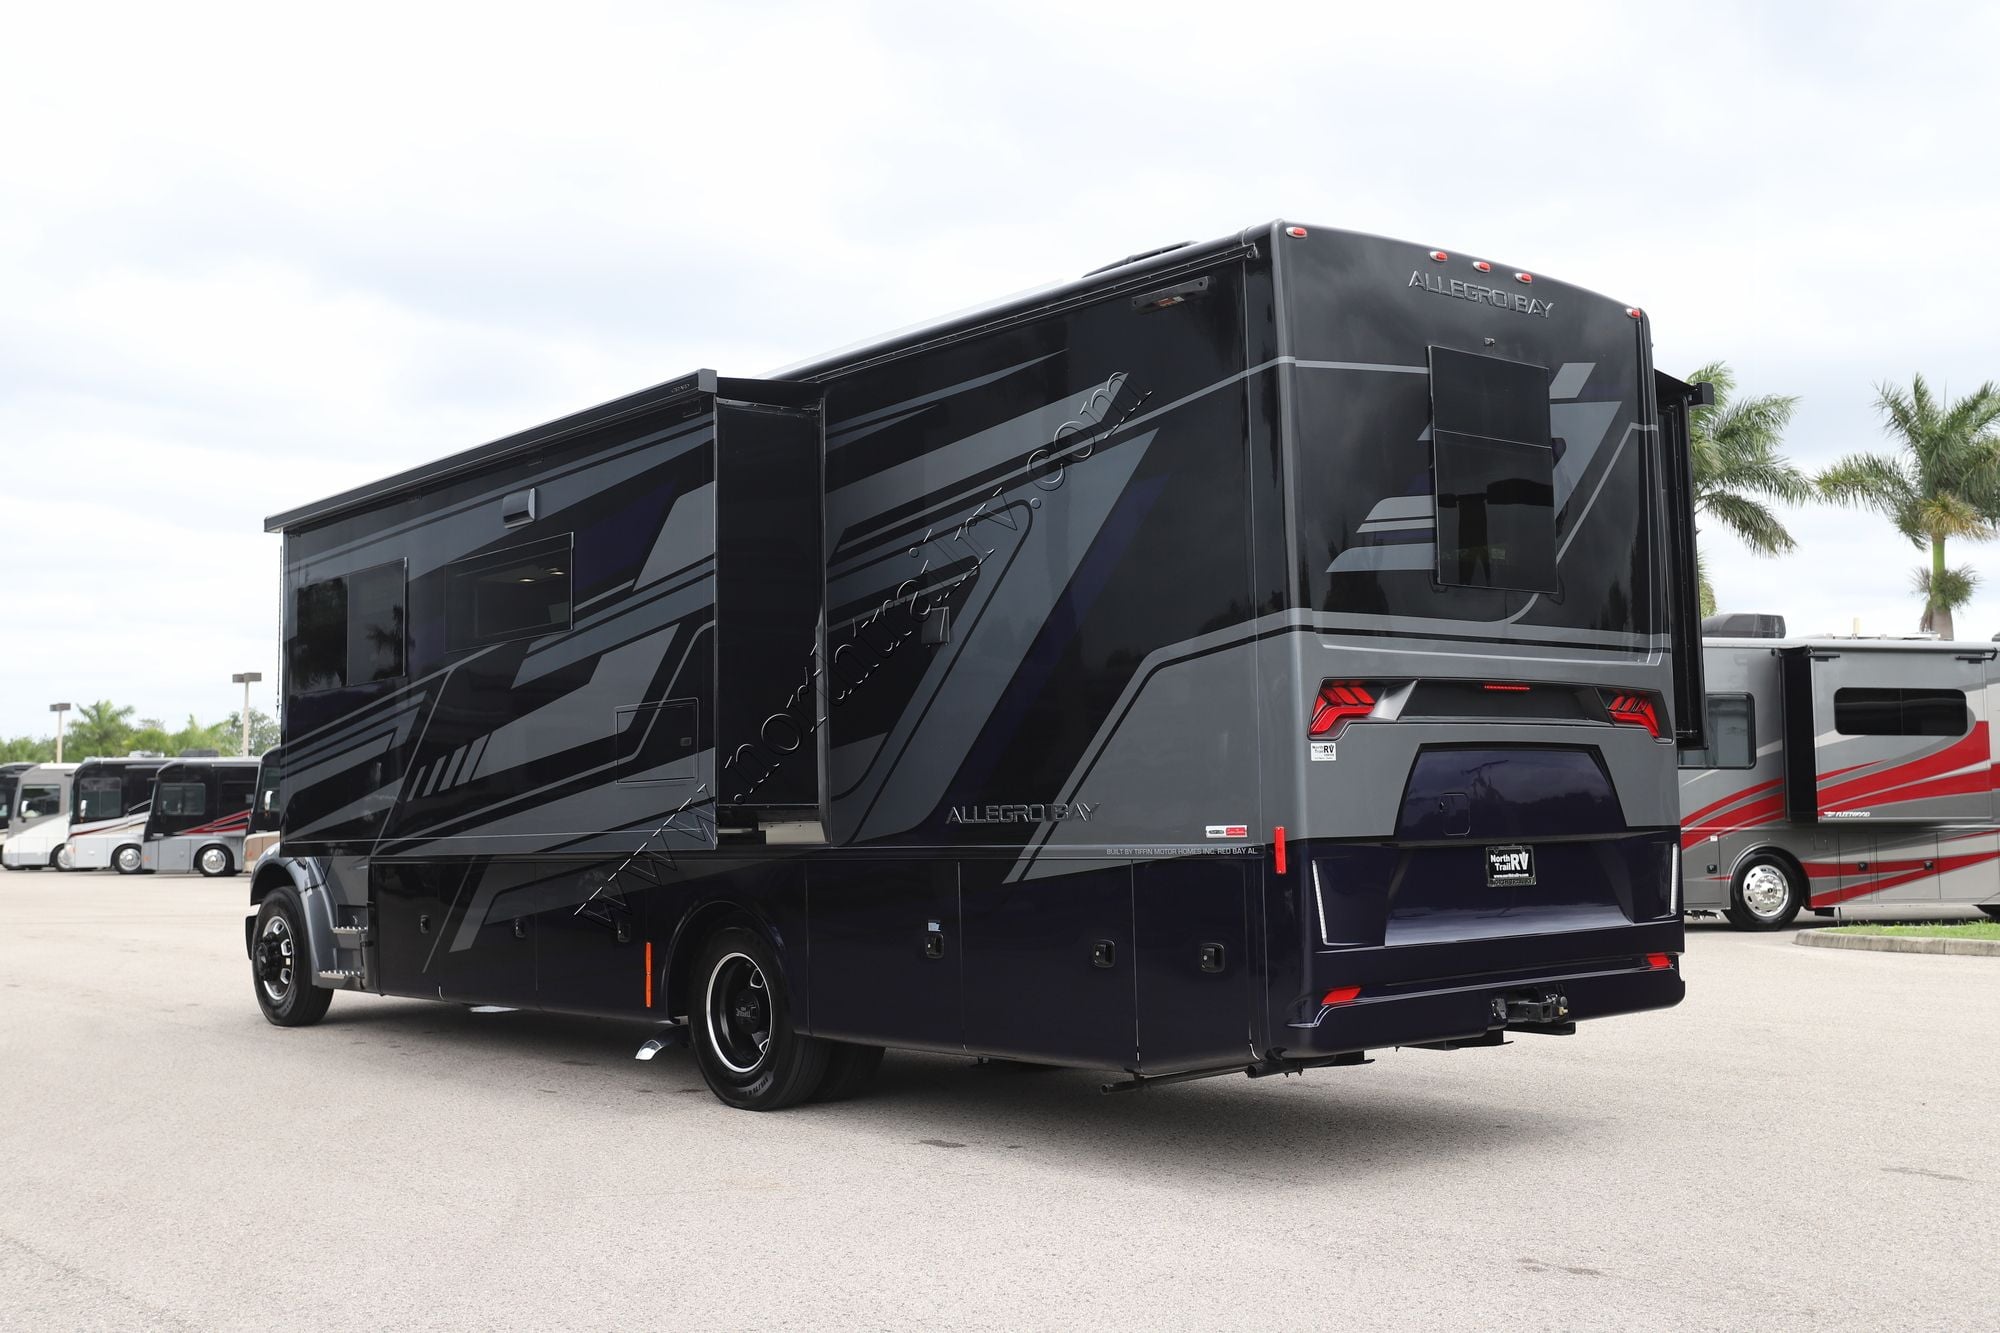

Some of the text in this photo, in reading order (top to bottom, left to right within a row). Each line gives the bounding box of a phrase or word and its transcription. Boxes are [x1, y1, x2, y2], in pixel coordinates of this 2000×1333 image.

[1408, 270, 1554, 319] ALLEGRO BAY
[945, 802, 1101, 824] ALLEGRO BAY
[1178, 847, 1201, 855] HOMES
[1490, 851, 1529, 870] North RV
[1495, 862, 1511, 871] Trail
